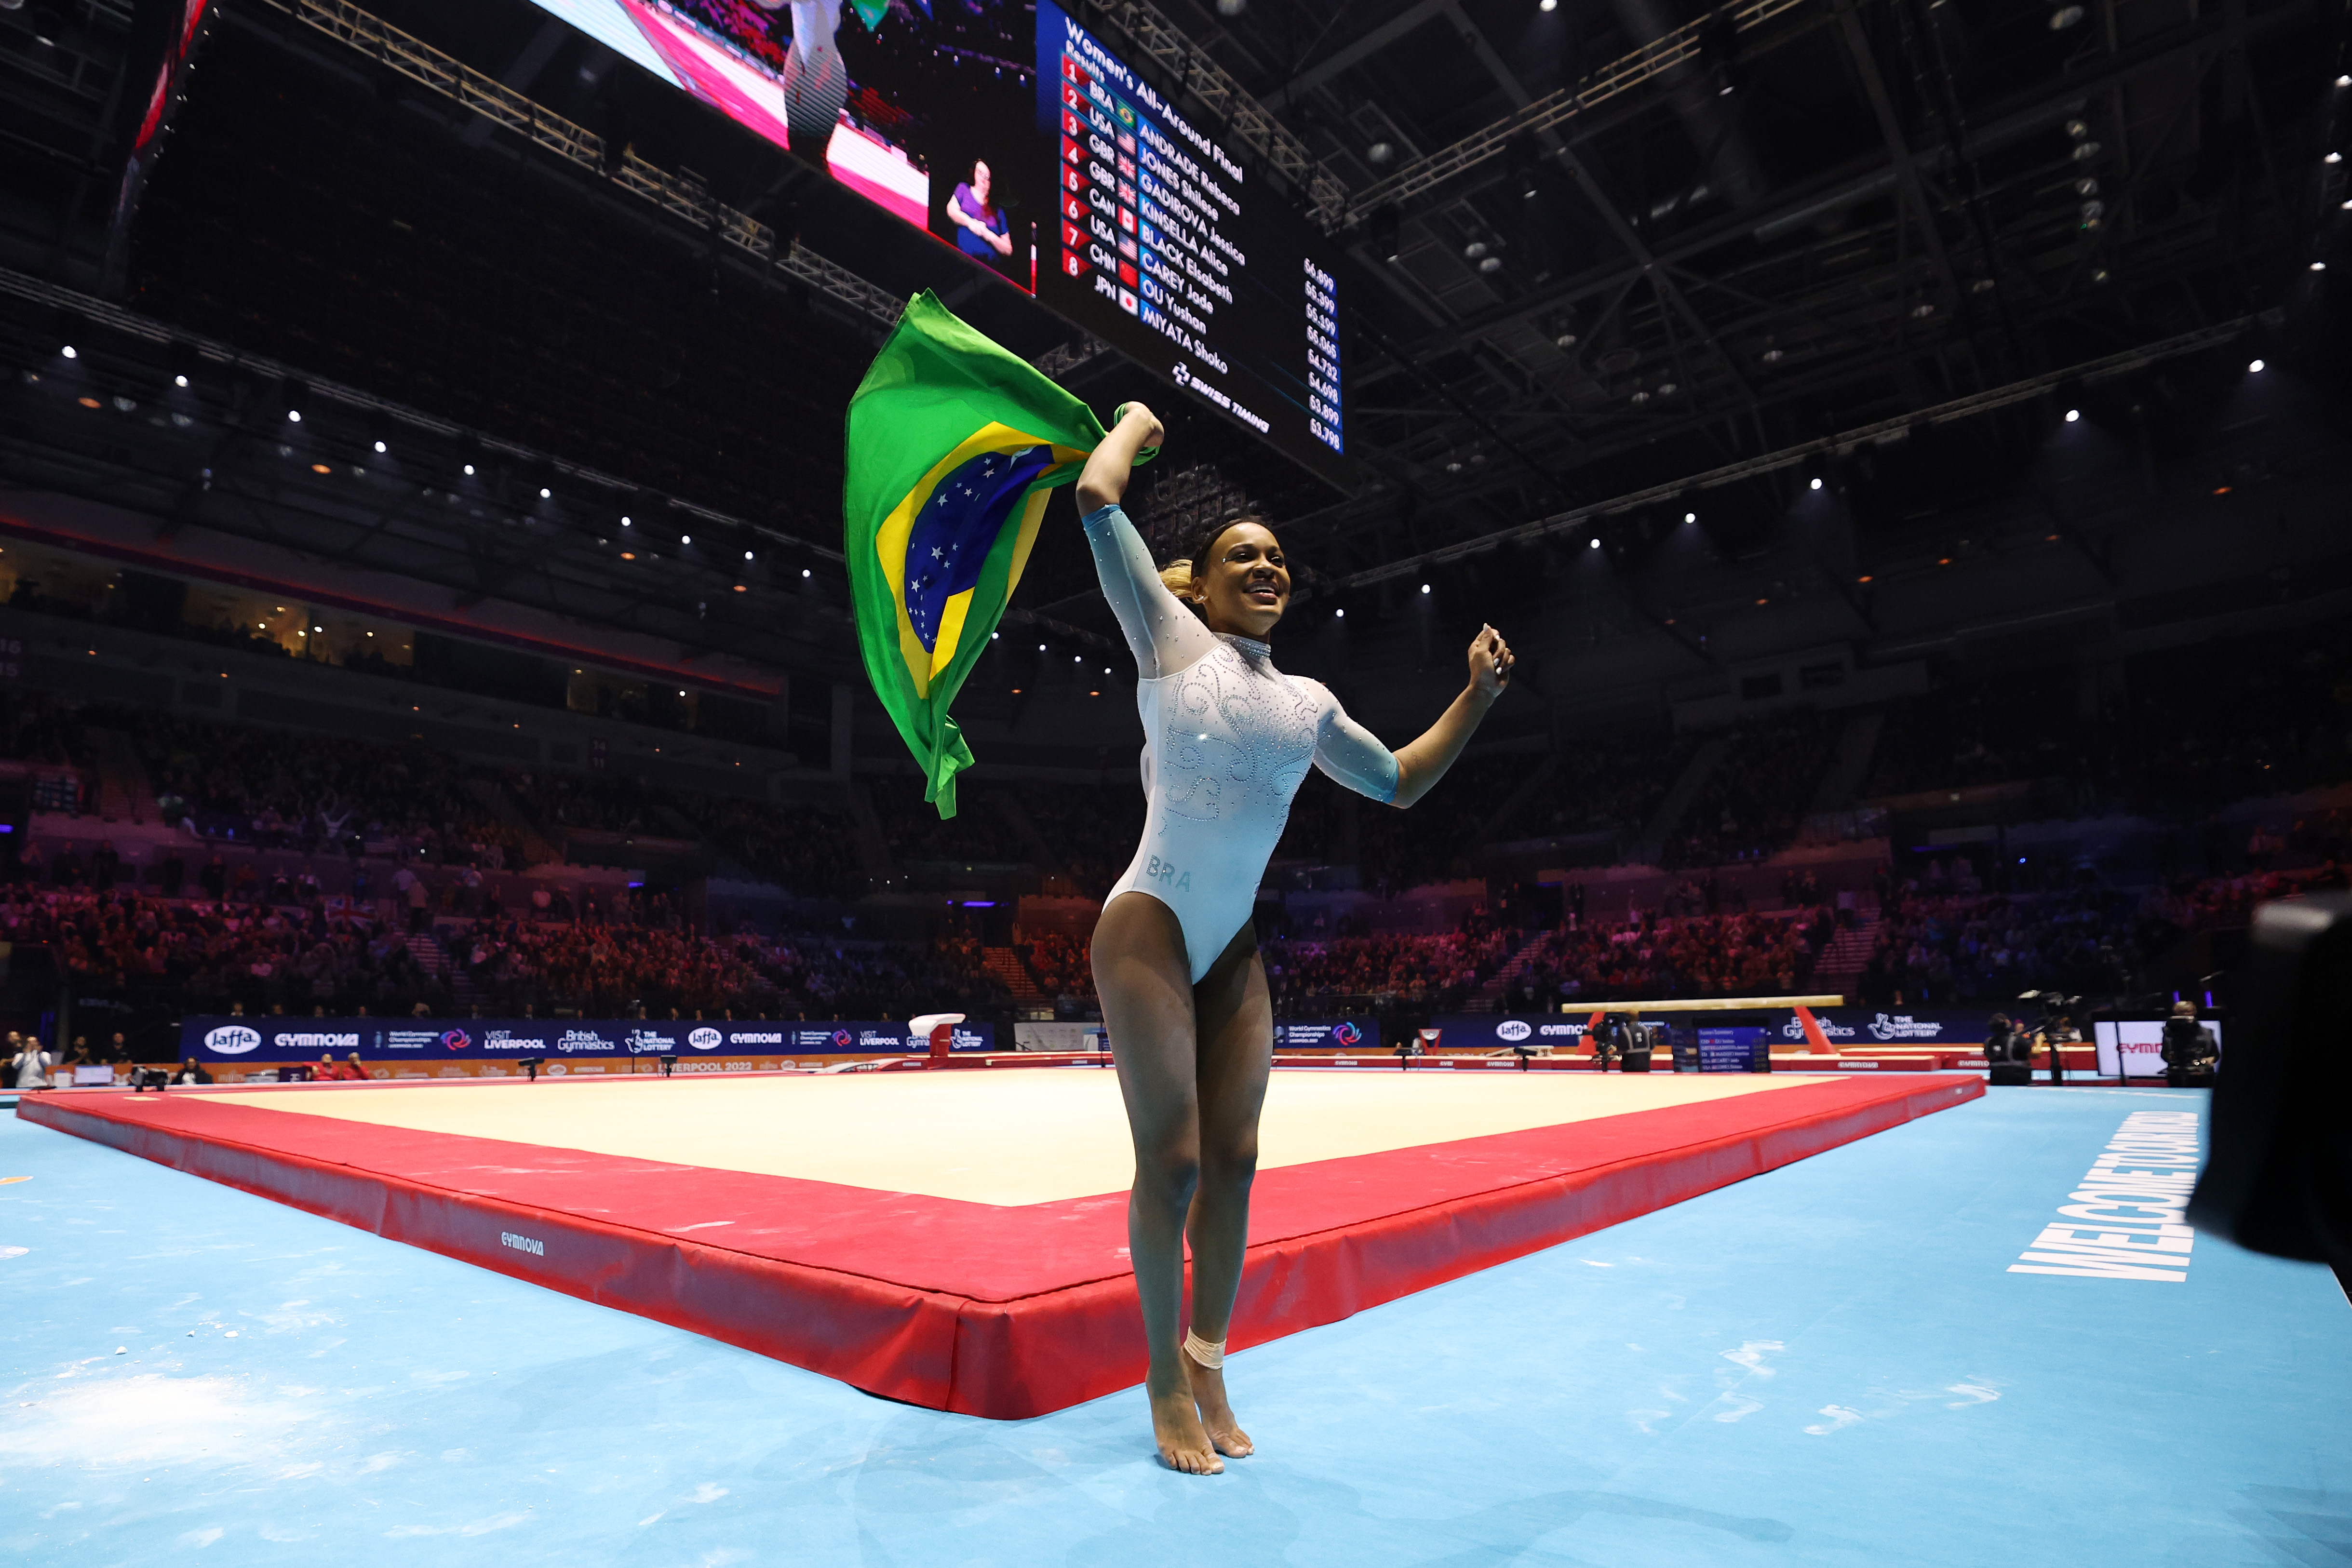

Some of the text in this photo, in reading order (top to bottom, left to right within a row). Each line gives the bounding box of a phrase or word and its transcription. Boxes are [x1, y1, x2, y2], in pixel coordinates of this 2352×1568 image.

[1066, 40, 1104, 83] Results
[1065, 16, 1243, 184] Women's All-Around Final
[1068, 64, 1077, 83] 1
[1089, 80, 1115, 112] BRA
[1140, 124, 1199, 182] ANDRADE
[1201, 171, 1240, 215] Rebeca
[1068, 90, 1077, 110] 2
[1089, 105, 1115, 140] USA
[1141, 148, 1179, 190] JONES
[1182, 179, 1218, 221] Shilese
[1068, 117, 1078, 136] 3
[1089, 134, 1115, 166] GBR
[1141, 174, 1208, 239] GADIROVA
[1210, 227, 1245, 266] Jessica
[1068, 147, 1078, 164] 4
[1089, 161, 1115, 194] GBR
[1141, 198, 1198, 255] KINSELLA
[1200, 244, 1228, 276] Alice
[1069, 173, 1078, 191] 5
[1089, 188, 1115, 217] CAN
[1142, 225, 1183, 268] BLACK
[1186, 257, 1233, 304] Elsabeth
[1069, 201, 1078, 220] 6
[1090, 215, 1116, 248] USA
[1142, 253, 1184, 293] CAREY
[1187, 284, 1213, 315] Jade
[1069, 227, 1078, 245] 7
[1089, 243, 1116, 274] CHN
[1142, 280, 1163, 305] OU
[1165, 293, 1206, 335] Yushan
[1069, 255, 1078, 276] 8
[1094, 274, 1116, 301] JPN
[1143, 307, 1193, 352] MIYATA
[1194, 339, 1228, 374] Shoko
[1191, 376, 1269, 433] SWISS TIMING
[1146, 855, 1190, 892] BRA
[274, 1033, 359, 1046] GYMNOVA
[484, 1039, 546, 1049] LIVERPOOL
[485, 1030, 511, 1039] VISIT
[558, 1038, 615, 1053] Gymnastics
[566, 1030, 598, 1041] British
[730, 1033, 782, 1044] GYMNOVA
[725, 1061, 752, 1071] 2022
[501, 1232, 544, 1256] GYMNOVA
[2006, 1168, 2197, 1282] WELCOME
